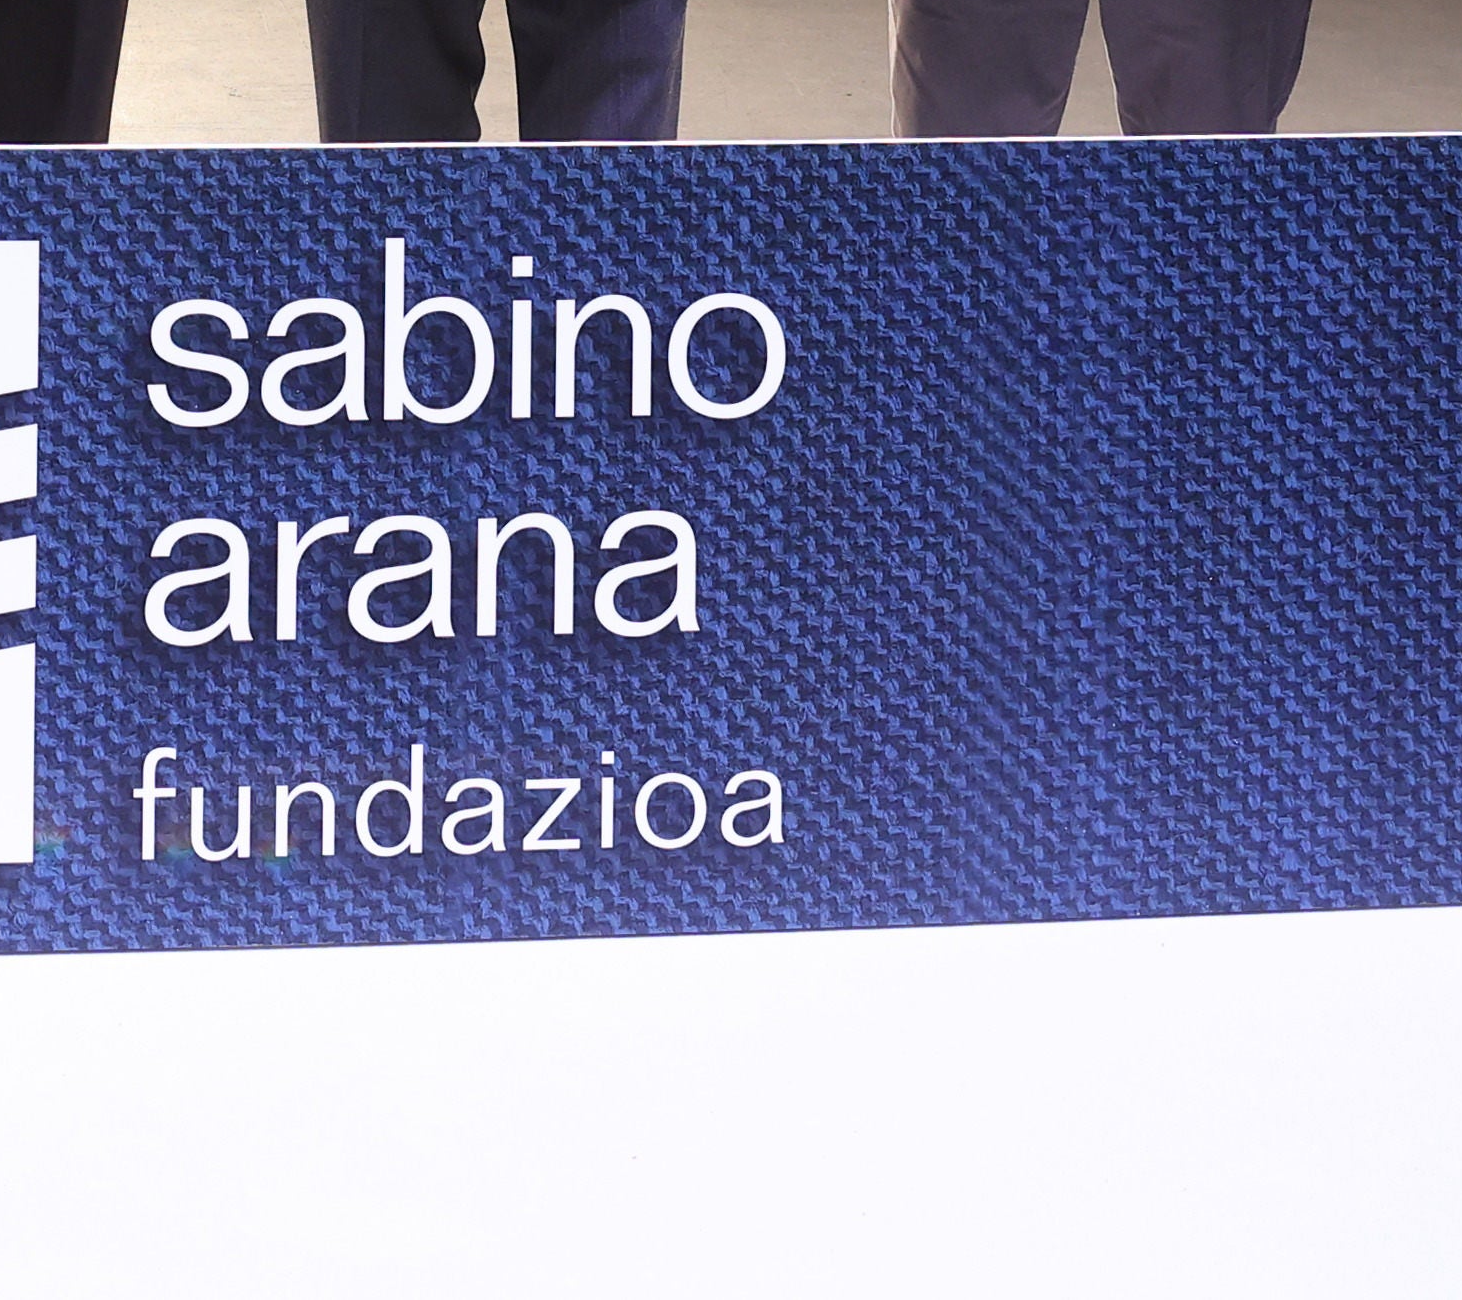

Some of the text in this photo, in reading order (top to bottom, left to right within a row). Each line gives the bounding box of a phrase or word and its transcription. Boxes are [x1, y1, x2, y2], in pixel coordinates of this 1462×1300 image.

[146, 237, 787, 427] sabino
[143, 509, 701, 648] arana
[132, 743, 786, 862] fundazioa
